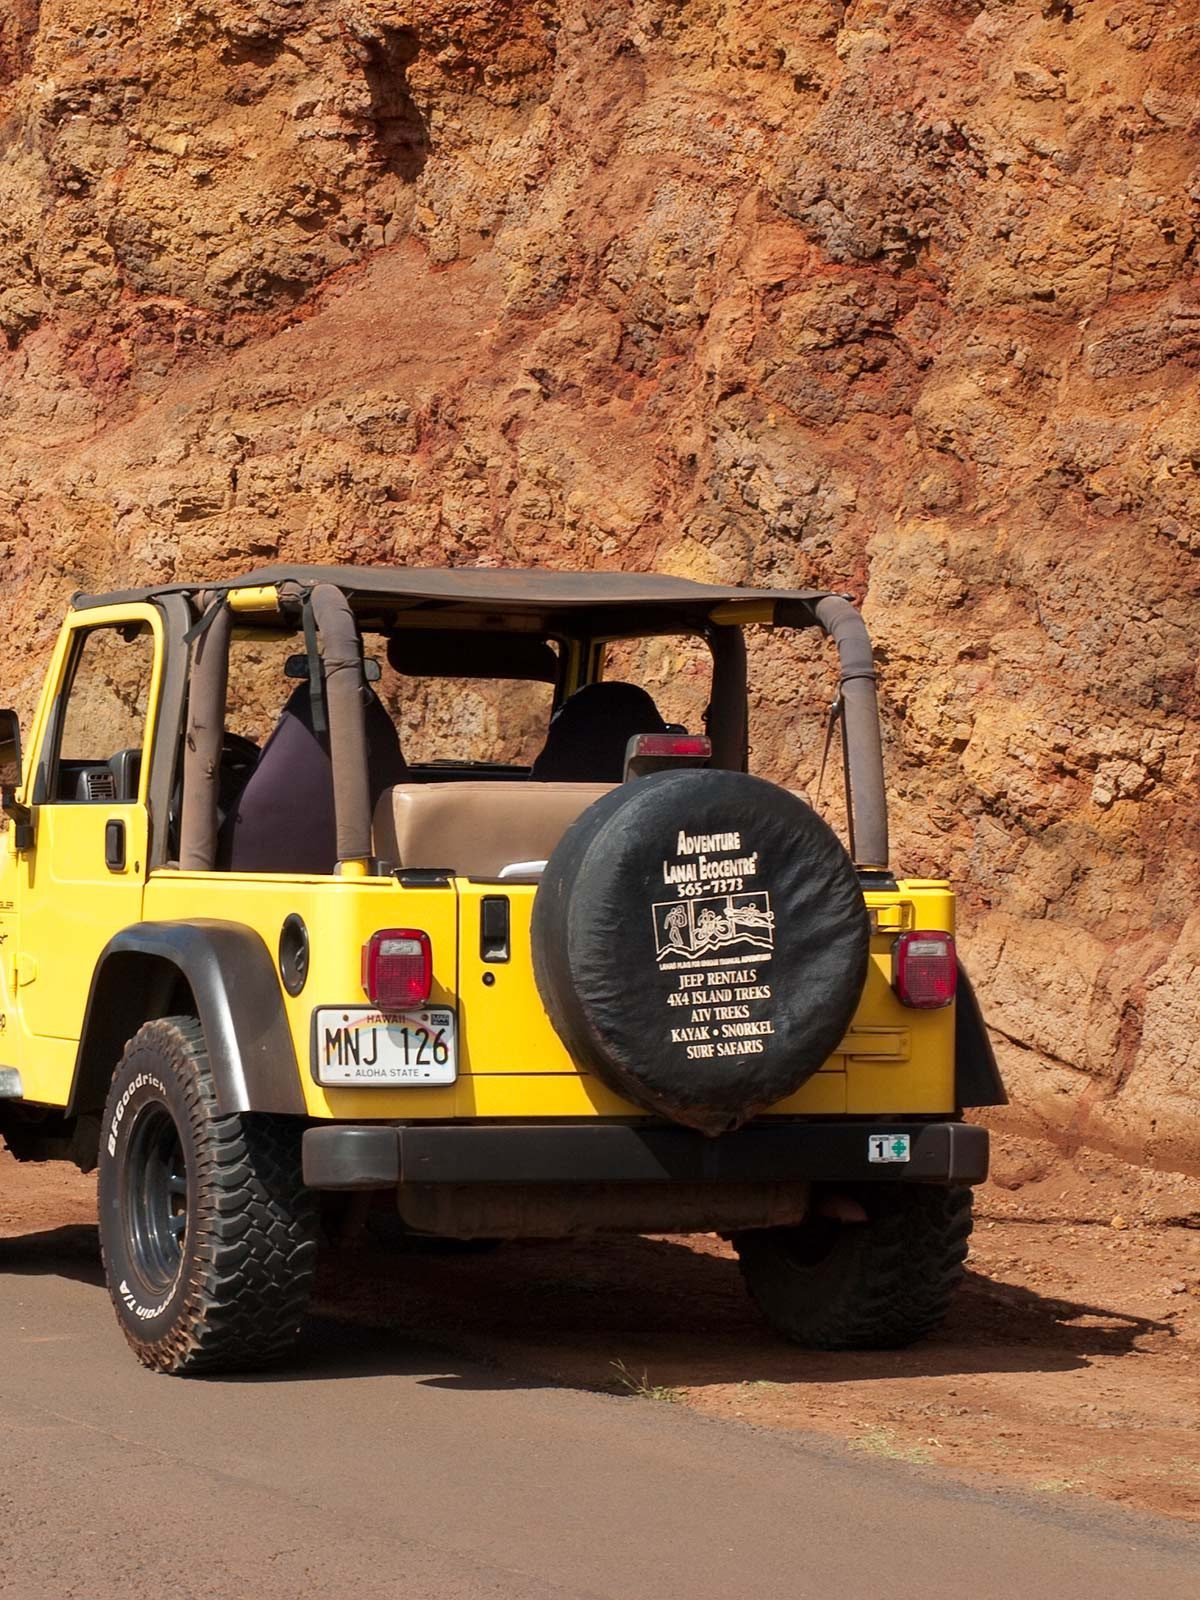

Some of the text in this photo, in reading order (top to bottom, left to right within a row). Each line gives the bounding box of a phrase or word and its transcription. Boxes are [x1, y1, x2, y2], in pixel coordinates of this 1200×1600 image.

[677, 830, 741, 856] ADVENTURE
[663, 855, 756, 885] LANAI ECOCENTRE
[677, 878, 744, 897] 565-7373
[678, 969, 757, 990] JEEP RENTALS
[666, 985, 772, 1007] 4X4 ISLAND TREKS
[366, 1014, 406, 1024] HAWAII
[691, 1005, 750, 1023] ATV TREKS
[670, 1021, 775, 1043] KAYAK SNORKEL
[324, 1027, 450, 1067] MNJ 126
[686, 1039, 764, 1059] SURF SAFARIS
[355, 1068, 420, 1078] ALOHA STATE
[107, 1072, 167, 1158] BFGoodrich
[875, 1141, 883, 1158] 1
[119, 1279, 137, 1312] T/A
